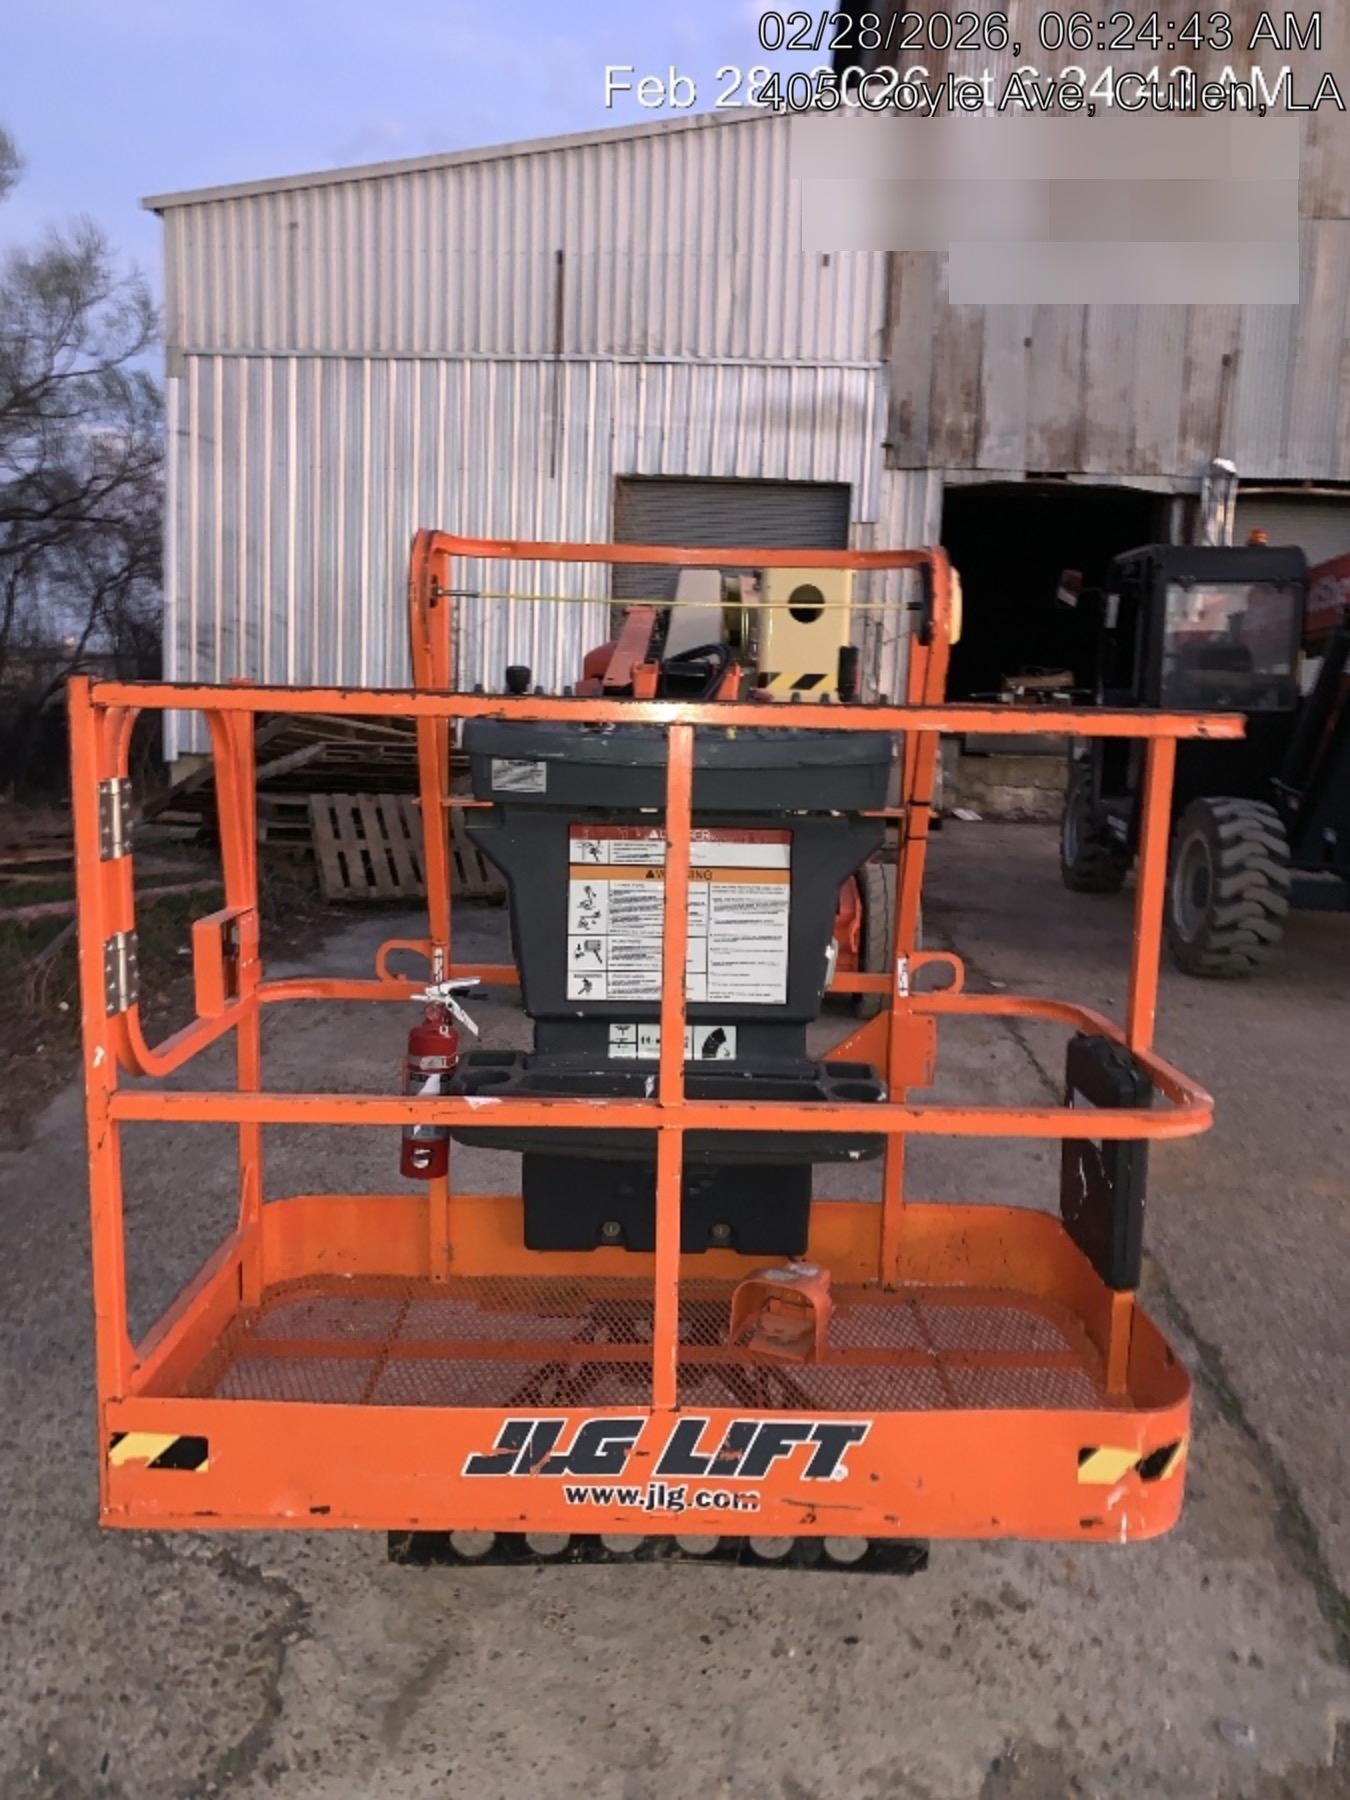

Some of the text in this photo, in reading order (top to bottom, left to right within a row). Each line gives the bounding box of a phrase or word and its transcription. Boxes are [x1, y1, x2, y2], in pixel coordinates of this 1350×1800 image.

[461, 1416, 872, 1480] JLG LIFT
[564, 1483, 760, 1513] www.jlg.com
